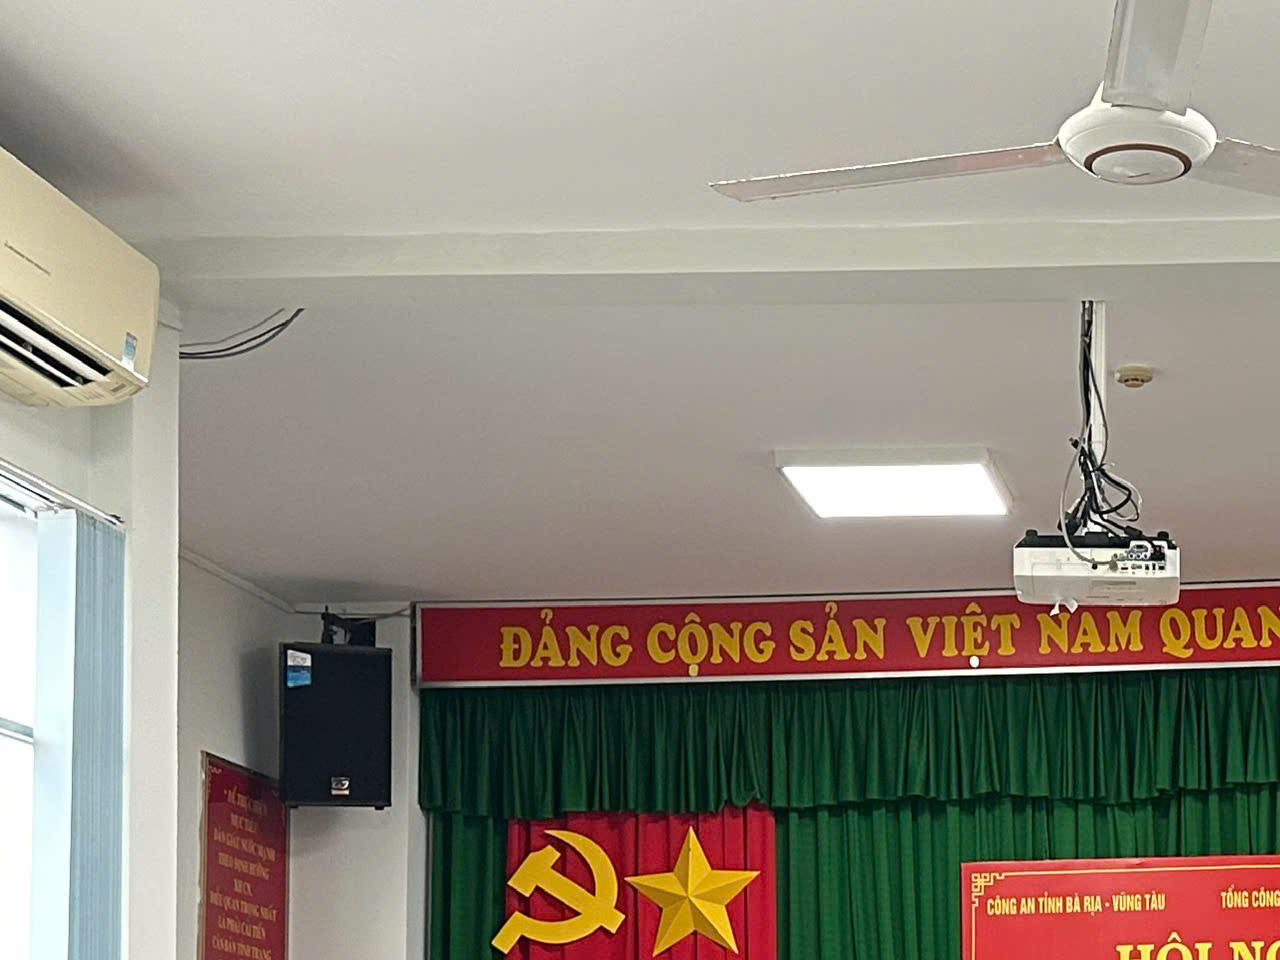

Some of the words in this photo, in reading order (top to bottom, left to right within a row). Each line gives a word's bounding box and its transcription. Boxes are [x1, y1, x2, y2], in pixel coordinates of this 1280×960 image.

[499, 608, 634, 669] ĐẢNG
[646, 612, 774, 677] CỘNG
[788, 602, 886, 662] SẢN
[906, 601, 1021, 669] VIỆT
[1036, 608, 1145, 656] NAM
[987, 895, 1017, 916] CÔNG
[1020, 898, 1035, 914] AN
[1038, 890, 1063, 914] TỈNH
[1066, 892, 1081, 913] BÀ
[1084, 895, 1102, 917] RỊA
[1112, 891, 1142, 912] VŨNG
[1144, 890, 1166, 911] TÀU
[1221, 883, 1249, 909] TỔNG
[1251, 886, 1280, 908] CÔNG
